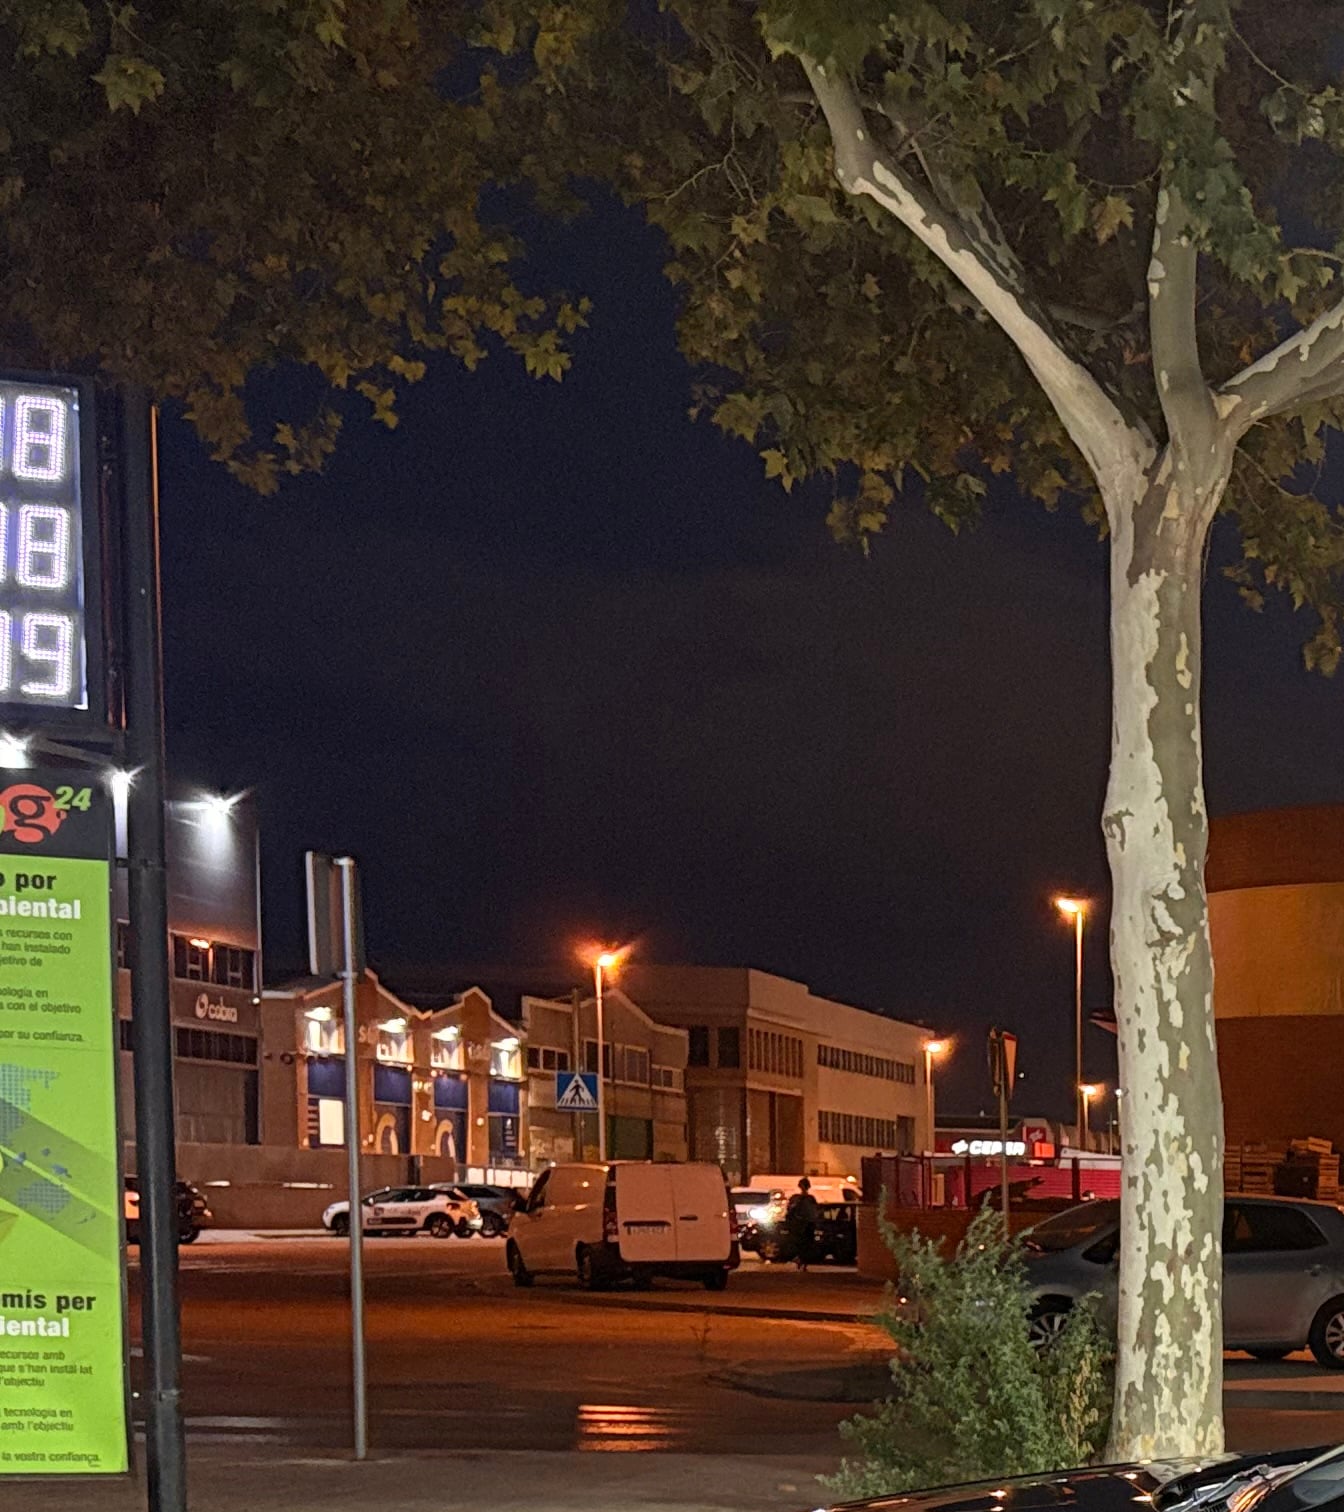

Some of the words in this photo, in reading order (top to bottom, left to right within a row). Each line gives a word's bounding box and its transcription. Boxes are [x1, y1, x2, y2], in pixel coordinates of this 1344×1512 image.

[53, 786, 92, 812] 24
[15, 873, 57, 892] por
[53, 932, 73, 941] con
[29, 956, 43, 967] de
[56, 1294, 96, 1314] per
